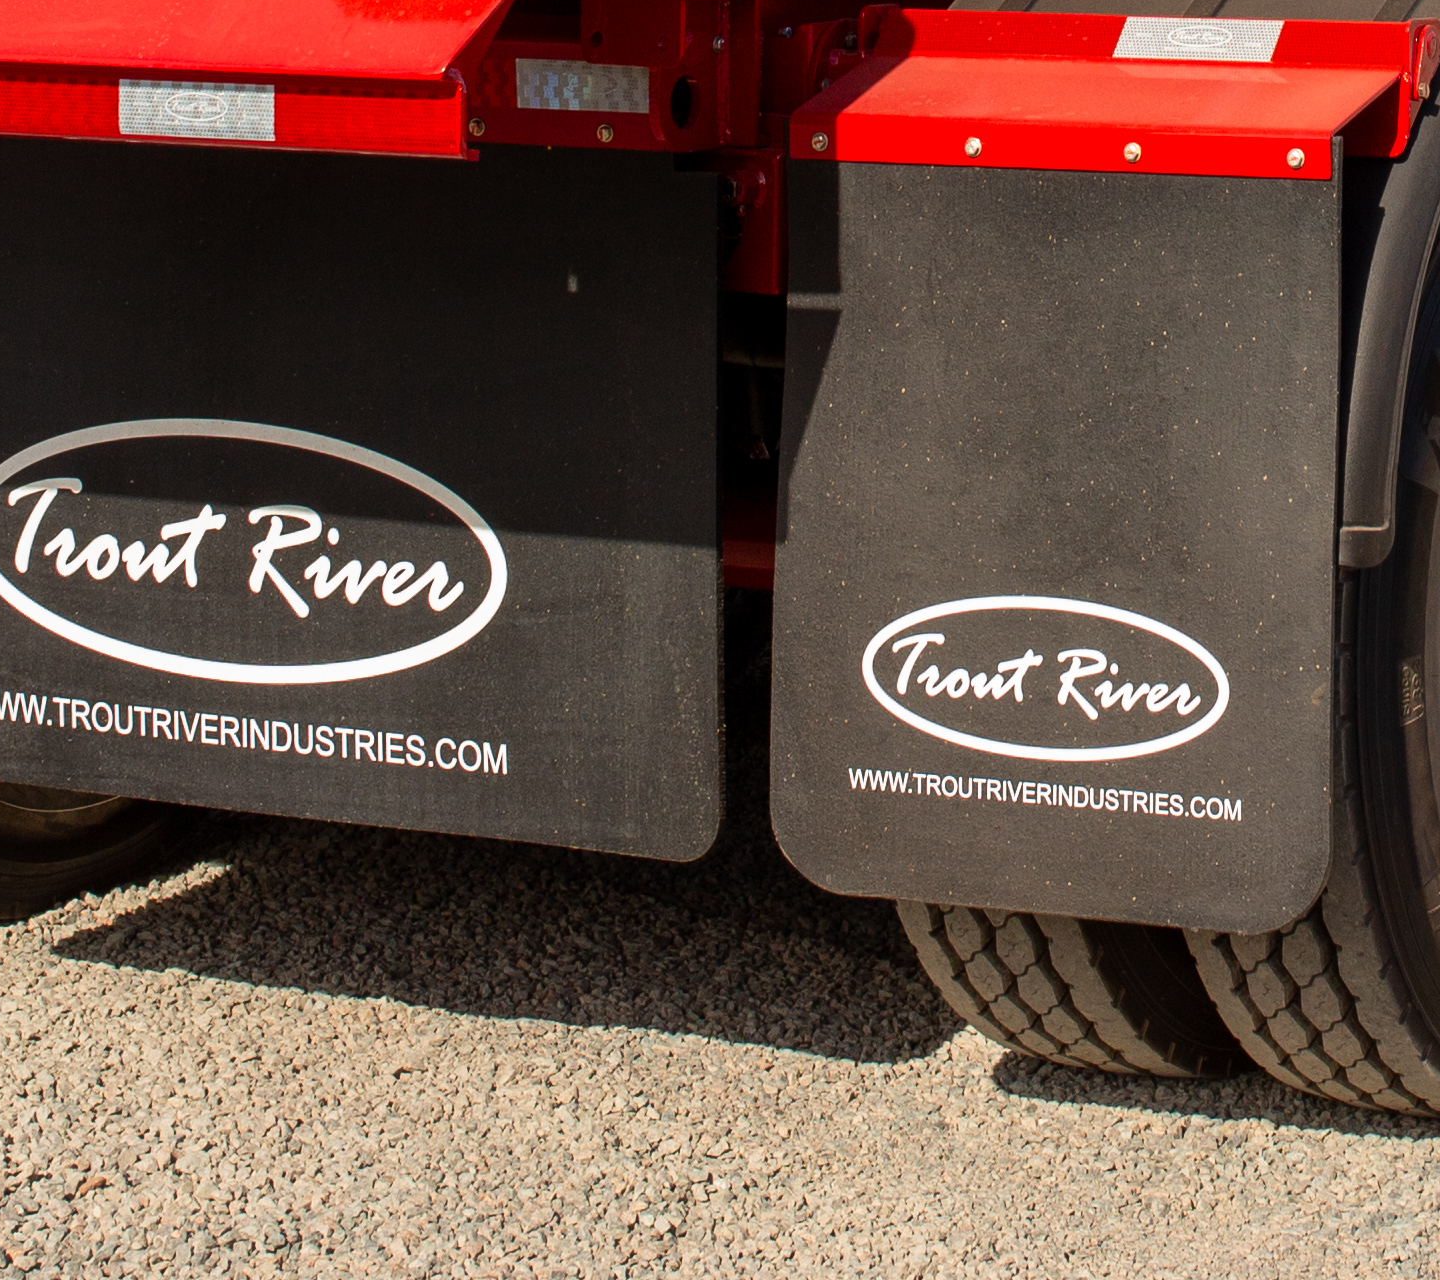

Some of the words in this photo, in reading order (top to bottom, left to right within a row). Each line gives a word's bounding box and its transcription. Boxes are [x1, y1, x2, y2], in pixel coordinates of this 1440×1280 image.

[7, 477, 226, 588] Trout
[248, 504, 464, 618] River
[892, 633, 1044, 703] Trout
[1057, 648, 1201, 720] River
[848, 768, 1243, 822] WWW.TROUTRIVERINDUSTRIES.COM
